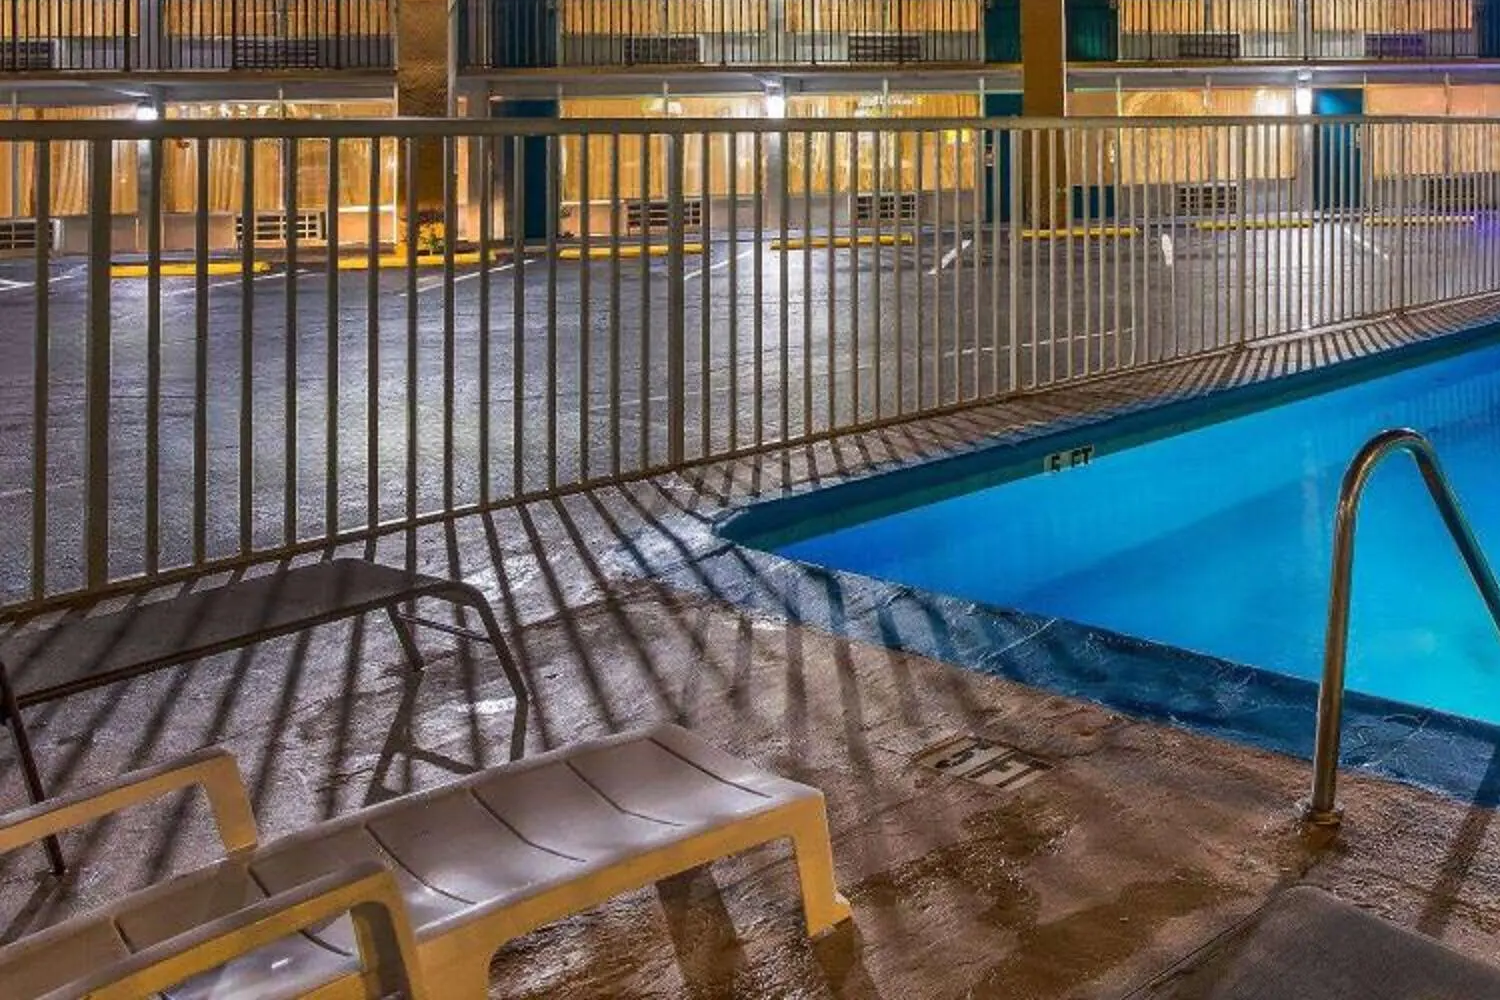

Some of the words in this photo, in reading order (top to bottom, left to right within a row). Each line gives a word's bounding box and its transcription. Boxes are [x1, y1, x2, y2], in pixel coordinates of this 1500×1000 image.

[1071, 448, 1092, 468] FT
[934, 738, 992, 769] 5
[968, 751, 1055, 788] FT
